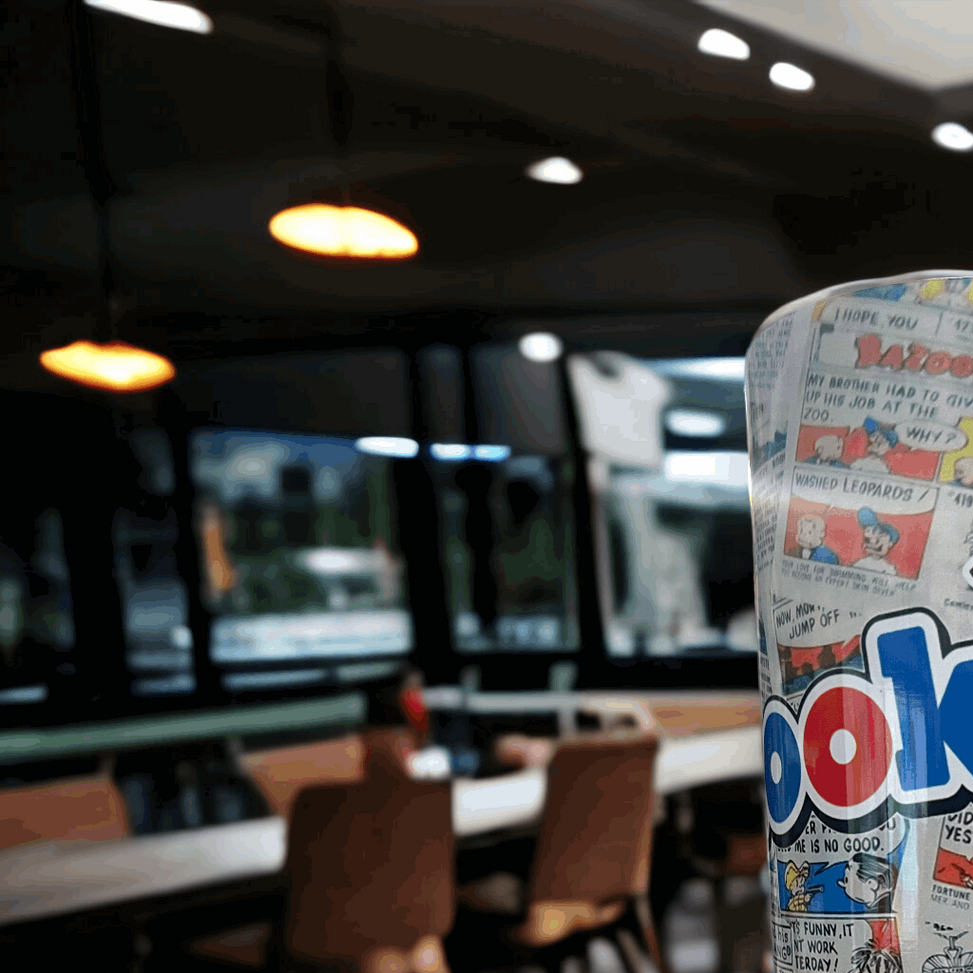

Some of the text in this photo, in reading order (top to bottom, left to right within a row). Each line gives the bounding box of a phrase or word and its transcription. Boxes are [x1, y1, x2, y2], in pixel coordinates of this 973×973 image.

[888, 315, 919, 330] YOU
[806, 372, 824, 389] MY
[829, 376, 880, 396] BROTHER
[886, 384, 916, 399] HAD
[923, 388, 940, 402] TO
[849, 396, 876, 411] JOB
[882, 402, 900, 414] AT
[795, 472, 838, 491] WASHED
[789, 608, 840, 640] JUMP OFF
[811, 839, 820, 854] IS
[824, 839, 838, 853] NO
[932, 884, 970, 901] FORTUNE
[952, 899, 970, 911] AND
[808, 941, 838, 955] WORK
